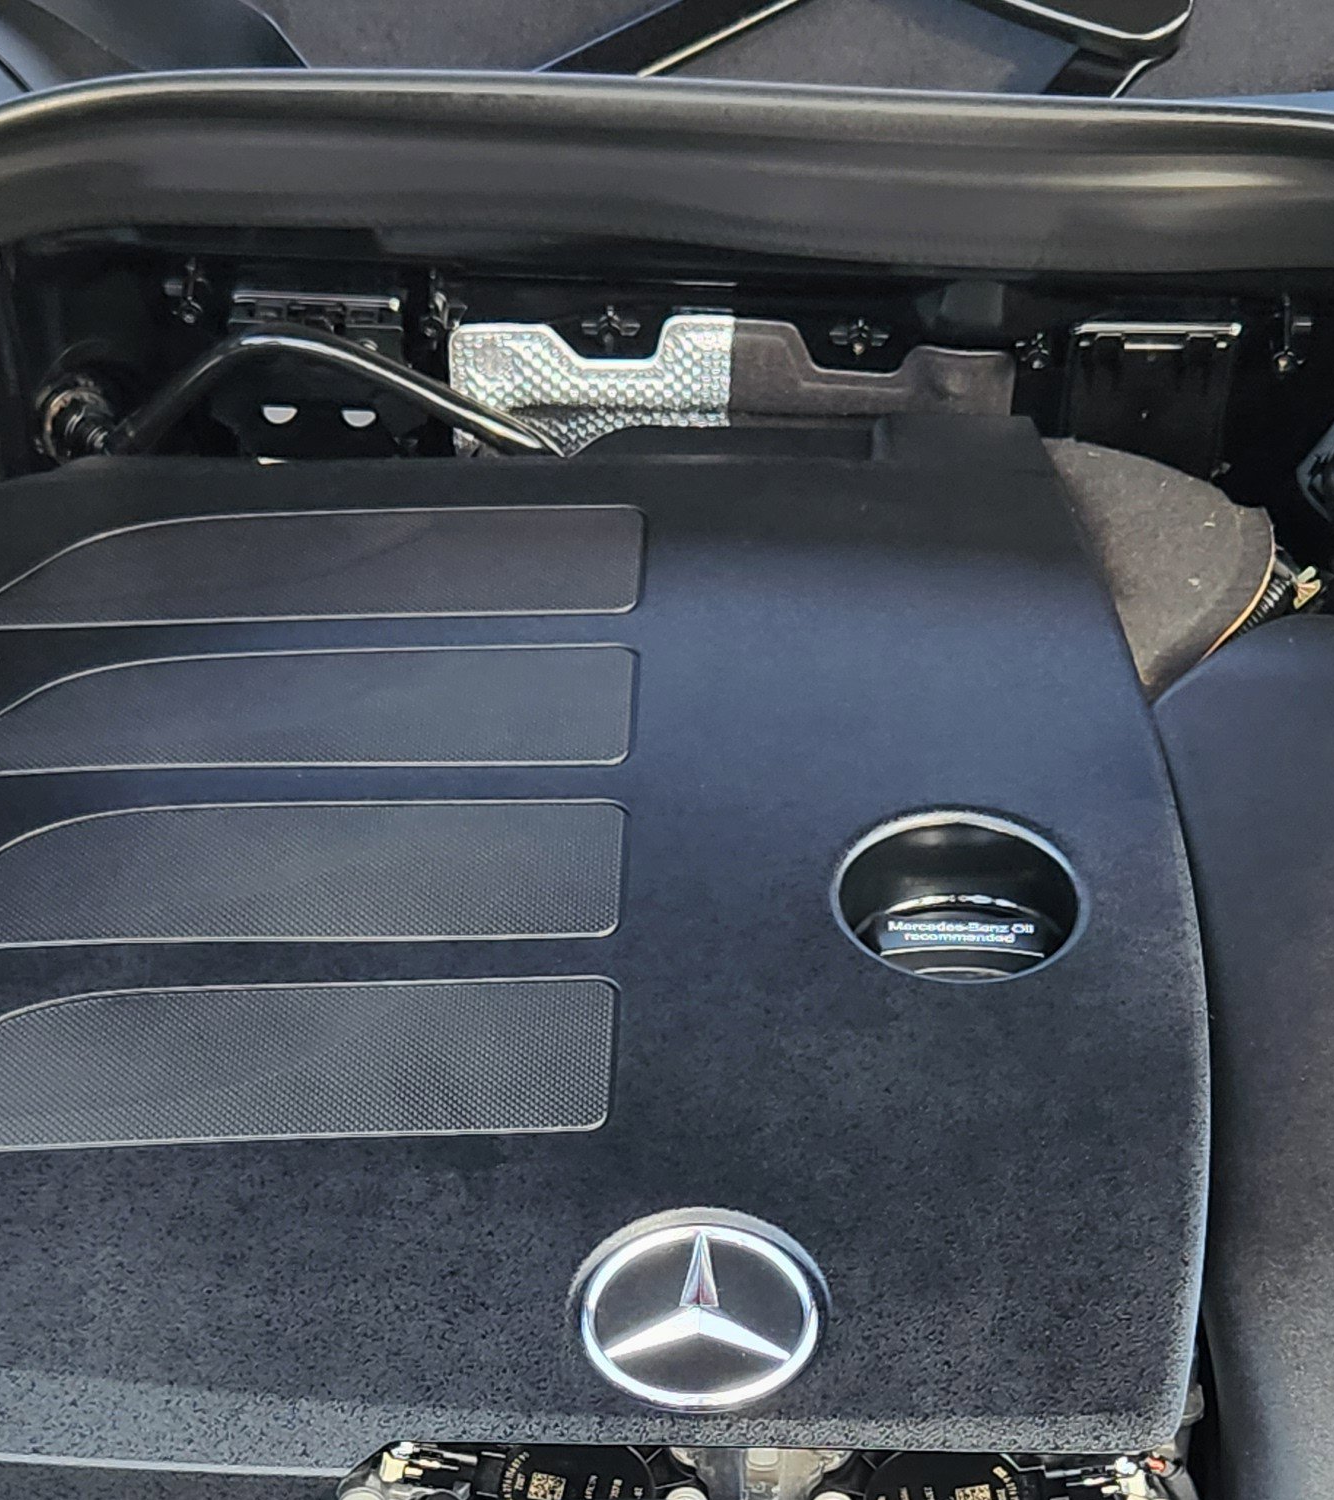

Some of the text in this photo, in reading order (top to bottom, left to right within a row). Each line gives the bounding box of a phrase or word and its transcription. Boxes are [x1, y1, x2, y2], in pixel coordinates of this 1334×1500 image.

[887, 920, 1034, 934] Mercedes-Benz Oil
[904, 933, 1015, 944] recommended
